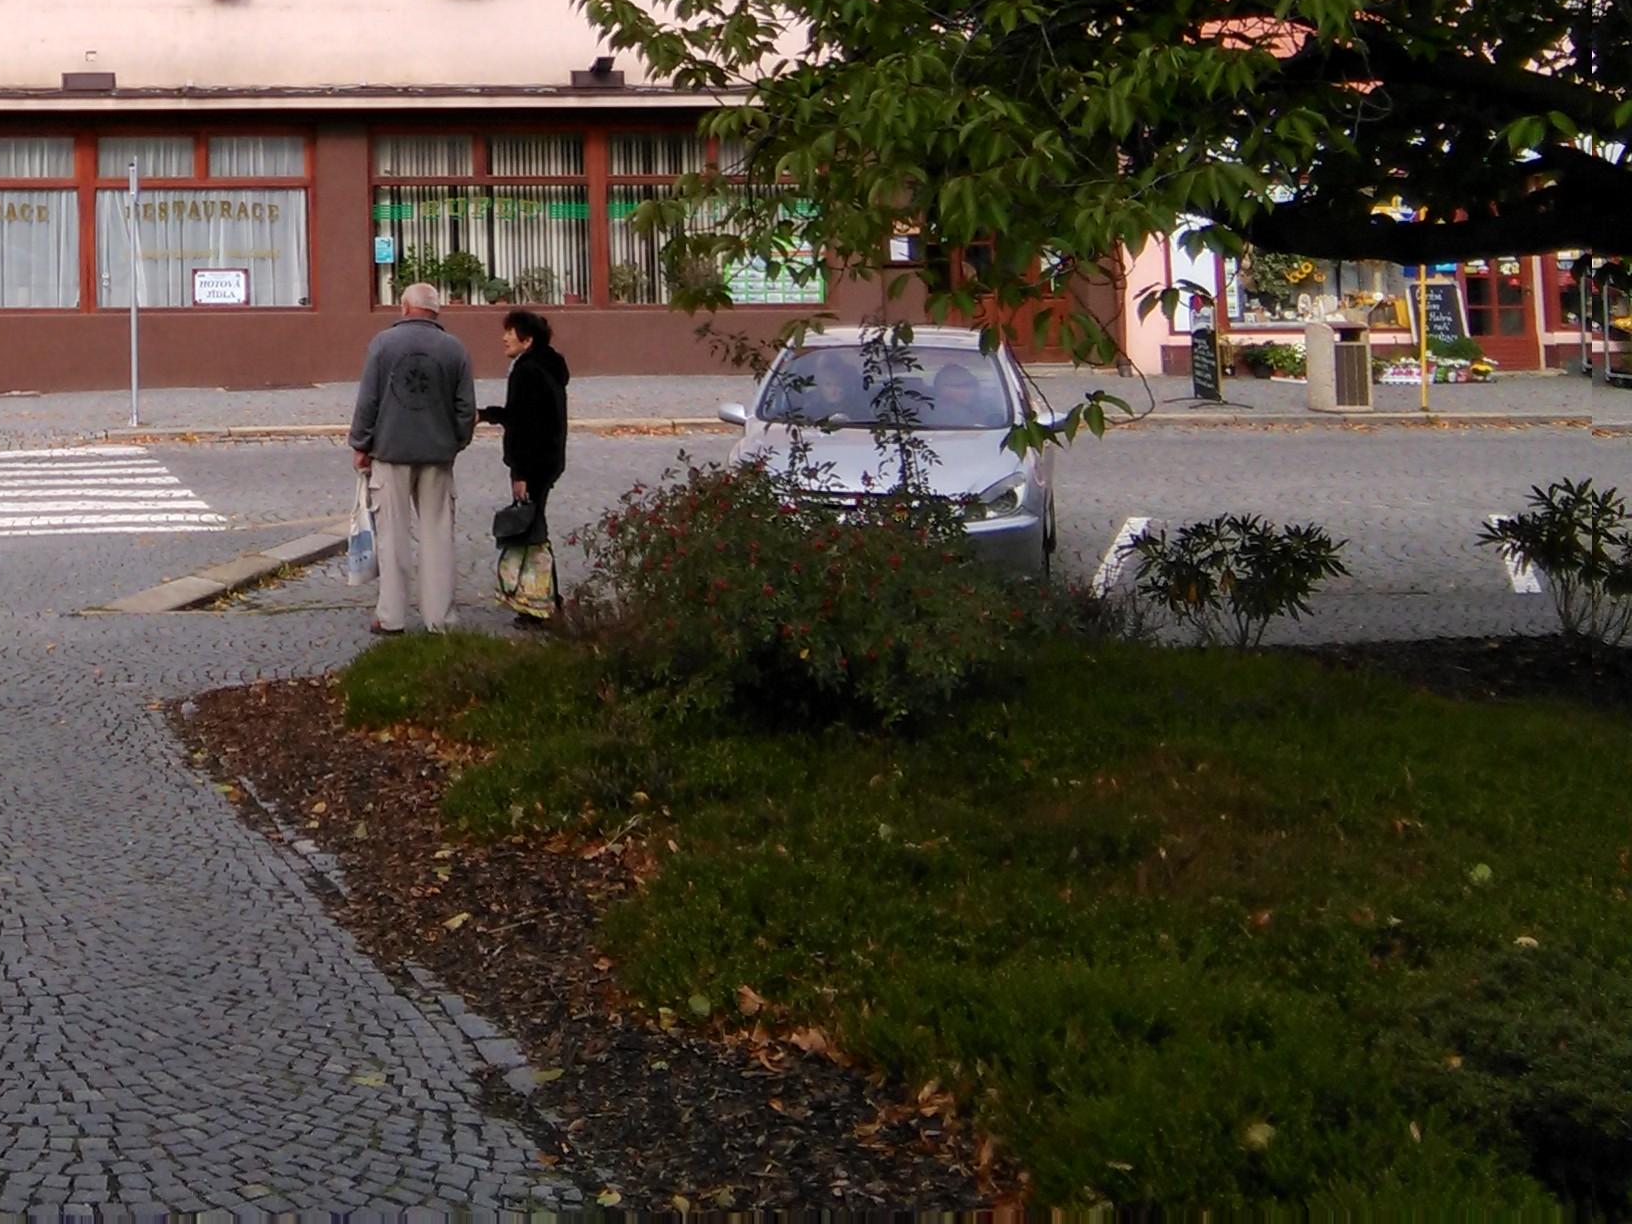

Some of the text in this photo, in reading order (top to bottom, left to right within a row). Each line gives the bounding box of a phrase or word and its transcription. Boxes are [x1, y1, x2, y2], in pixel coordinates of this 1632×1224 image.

[420, 197, 542, 220] BUFET
[199, 278, 241, 288] HOTOVÁ
[206, 289, 236, 298] JÍDLA
